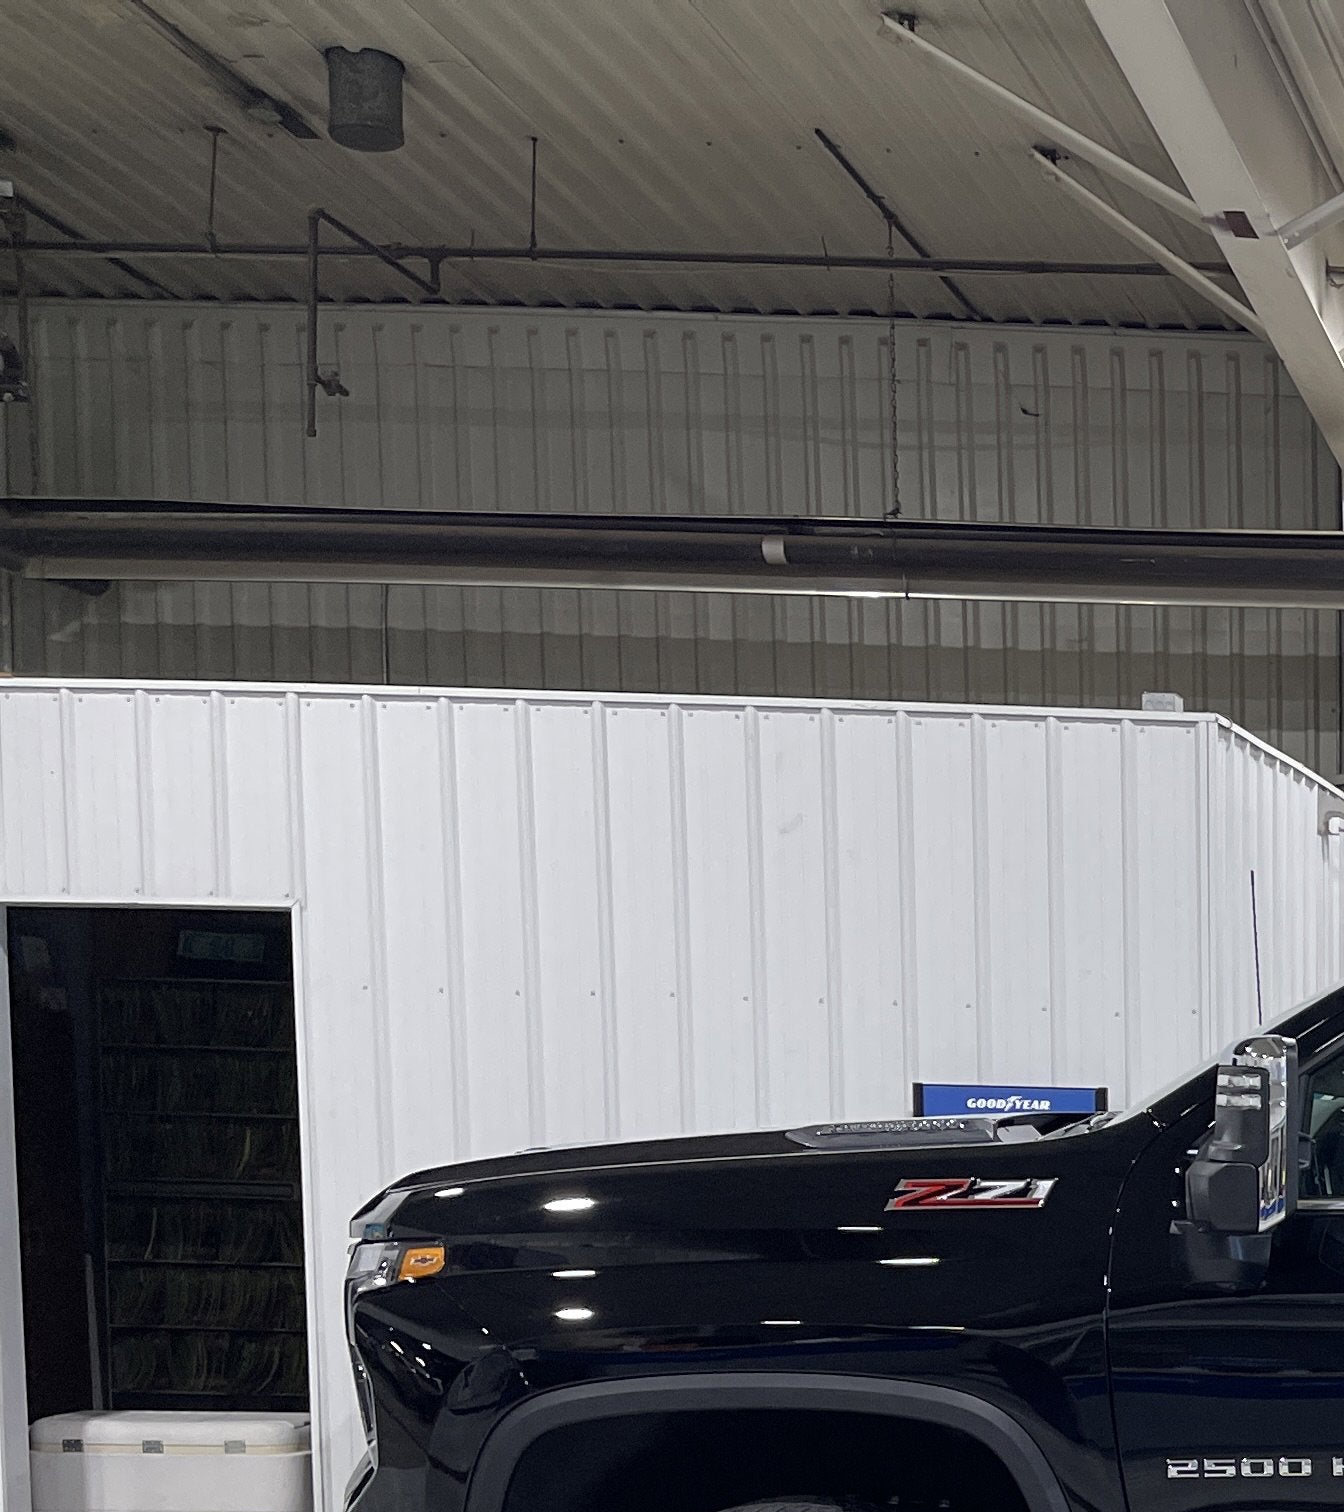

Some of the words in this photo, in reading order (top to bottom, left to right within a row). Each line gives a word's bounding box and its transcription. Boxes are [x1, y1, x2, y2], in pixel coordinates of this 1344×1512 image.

[967, 1095, 1050, 1112] GOODYEAR
[884, 1177, 1059, 1212] Z71
[1166, 1457, 1312, 1478] 2500
